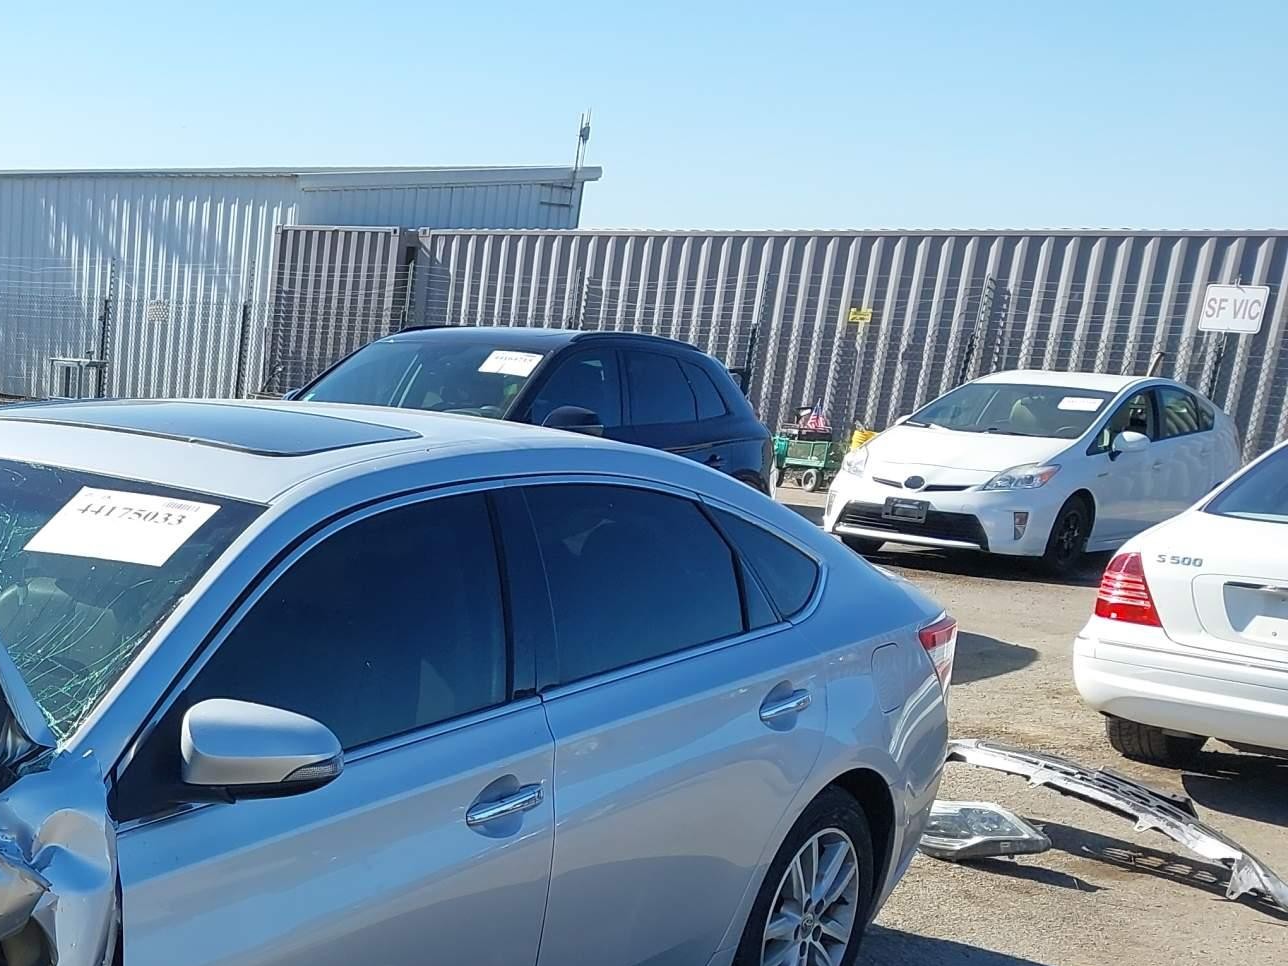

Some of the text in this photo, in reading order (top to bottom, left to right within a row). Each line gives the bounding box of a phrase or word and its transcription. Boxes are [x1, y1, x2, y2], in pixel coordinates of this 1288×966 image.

[1205, 297, 1261, 320] SF VIC
[77, 503, 187, 525] 44175033
[1156, 554, 1203, 567] S 500
